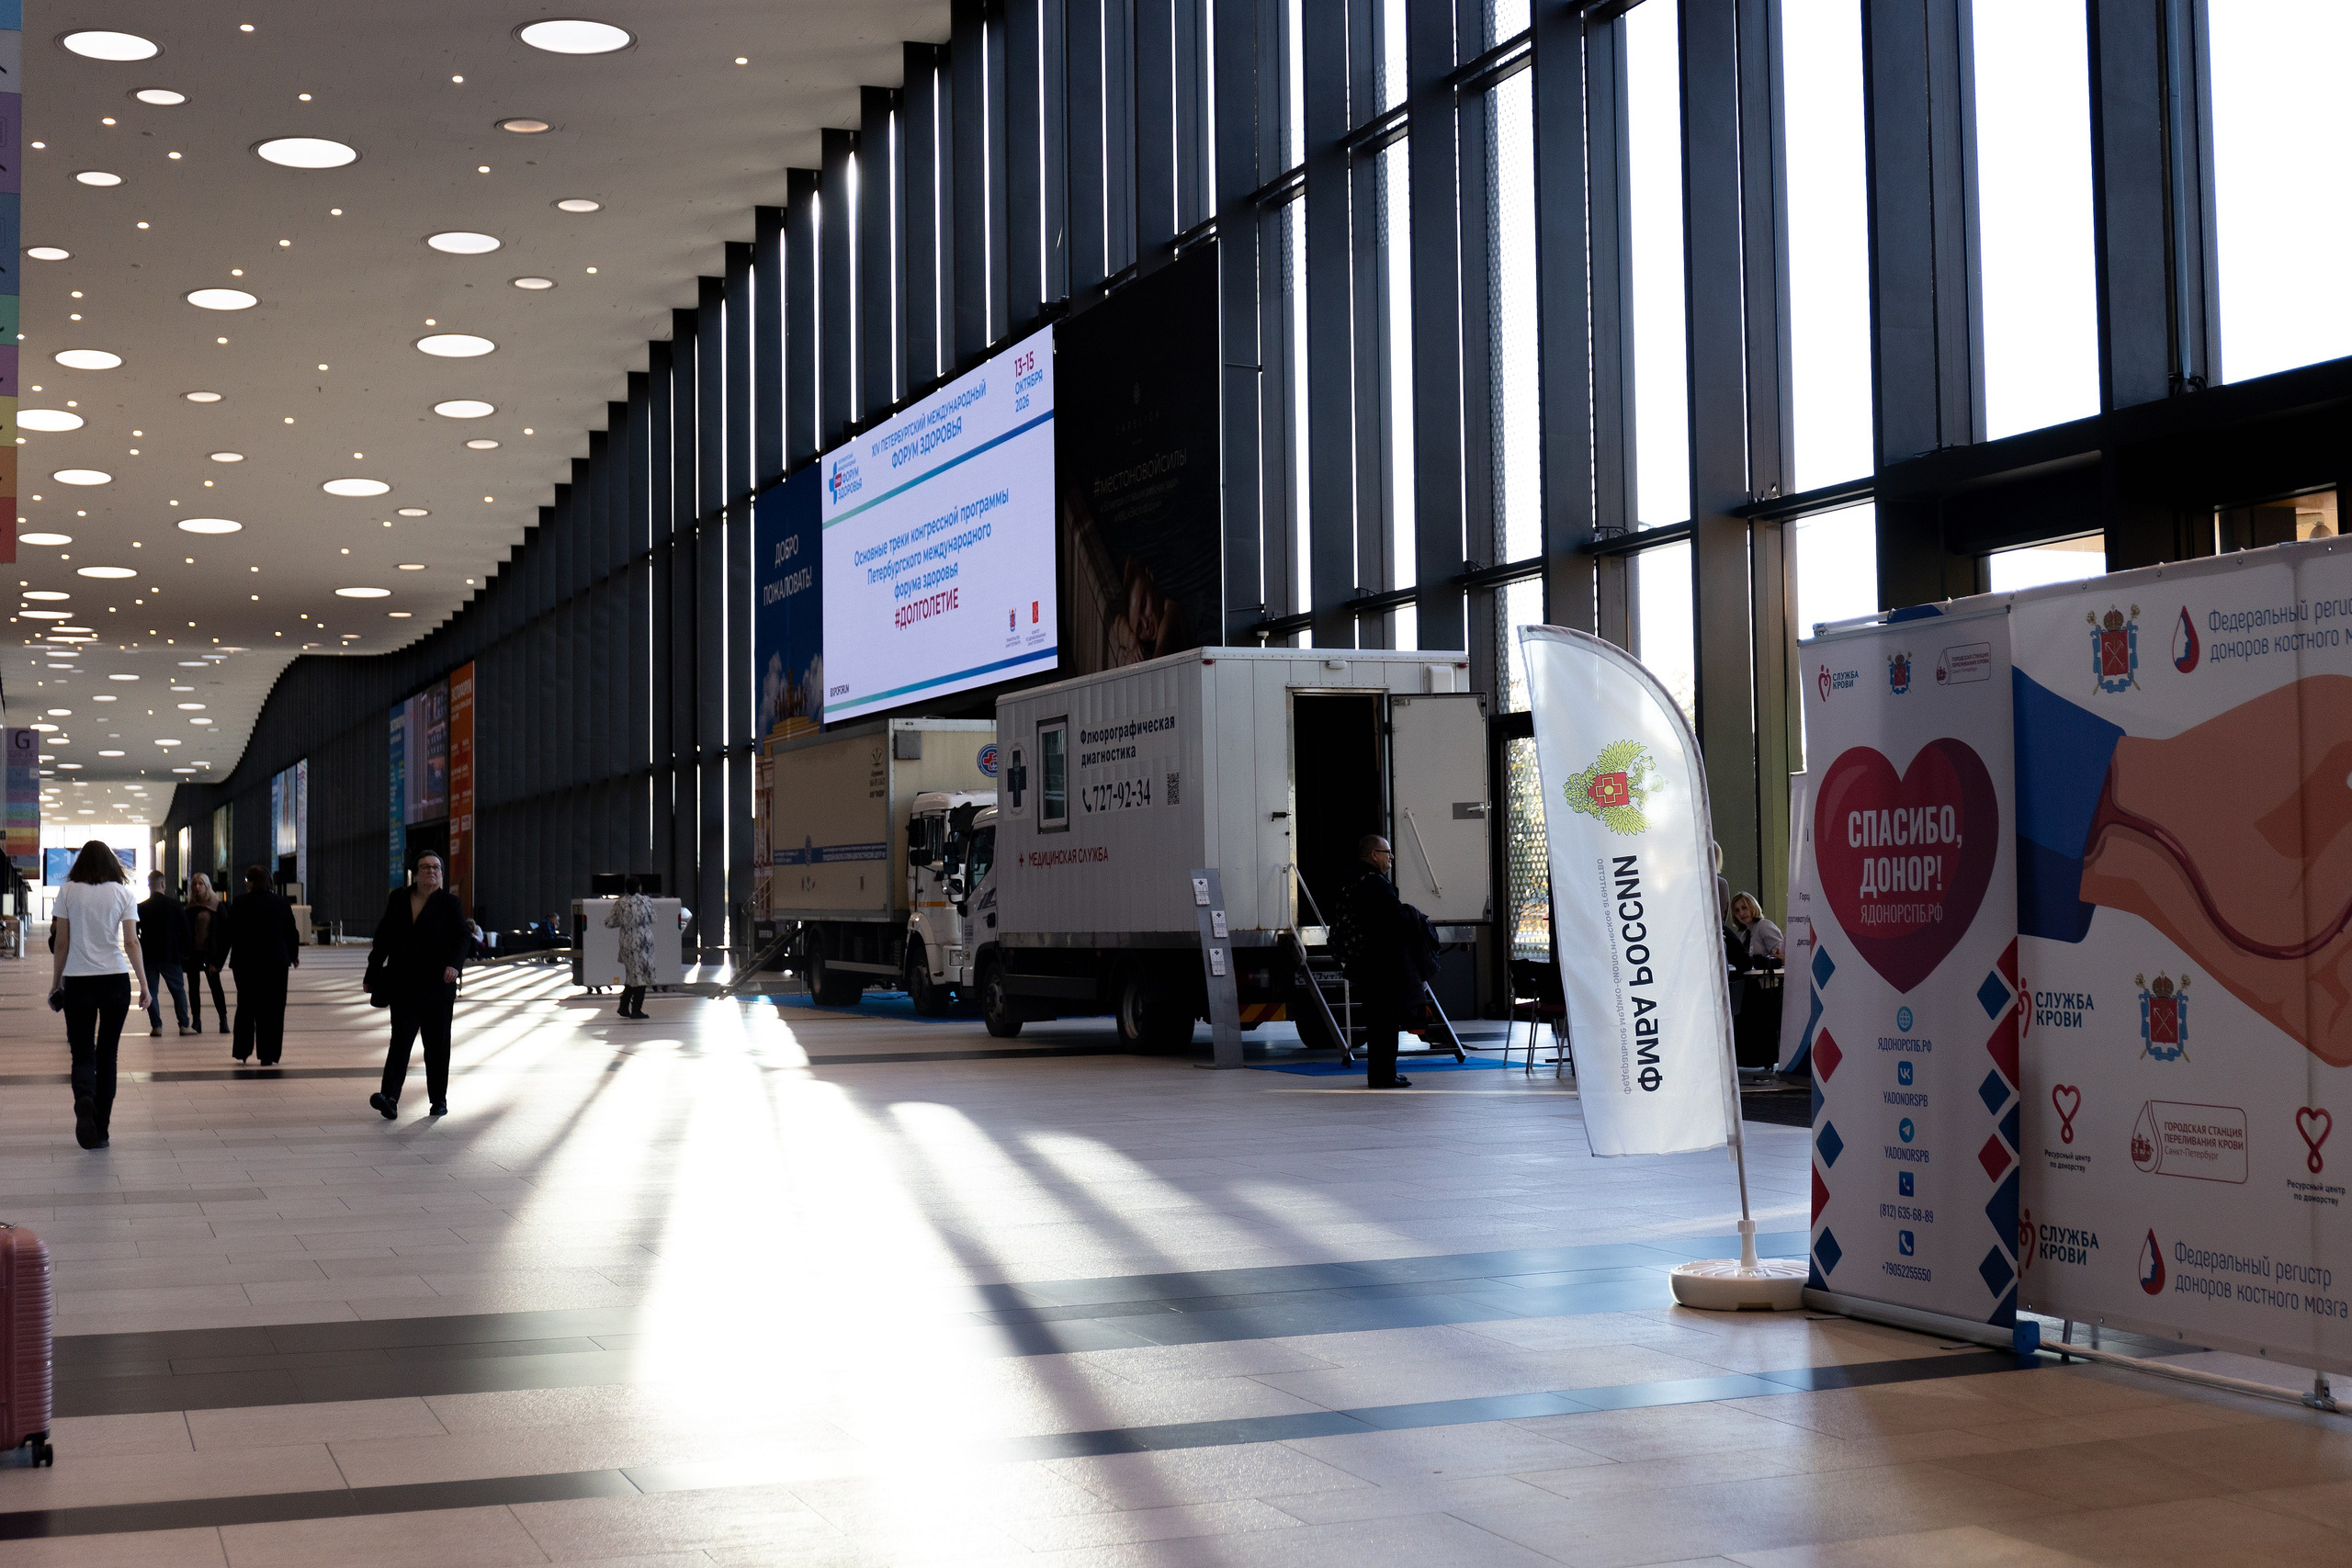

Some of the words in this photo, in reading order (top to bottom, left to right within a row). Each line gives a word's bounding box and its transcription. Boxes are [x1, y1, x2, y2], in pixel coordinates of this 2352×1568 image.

[1015, 368, 1043, 395] ОКТЯБРЯ
[1015, 393, 1030, 412] 2026
[871, 444, 880, 457] XIV
[881, 412, 926, 452] ПЕТЕРБУРГСКИЙ
[927, 378, 987, 427] МЕЖДУНАРОДНЫЙ
[891, 442, 919, 468] ФОРУМ
[920, 415, 962, 456] ЗДОРОВЬЯ
[842, 466, 859, 483] ФОРУМ
[838, 478, 863, 500] ЗДОРОВЬЯ
[854, 541, 888, 567] Основные
[889, 532, 910, 555] треки
[910, 505, 959, 544] конгрессной
[961, 488, 1009, 525] программы
[775, 534, 799, 569] ДОБРО
[867, 551, 922, 585] Петербургского
[922, 523, 991, 563] международного
[763, 565, 812, 606] ПОЖАЛОВАТЬ!
[894, 577, 922, 603] форума
[922, 562, 958, 589] здоровья
[894, 587, 959, 631] #ДОЛГОЛЕТИЕ
[2208, 599, 2308, 634] Федеральный
[2211, 637, 2269, 663] доноров
[2274, 629, 2339, 653] костного
[1832, 670, 1859, 681] СЛУЖБА
[1832, 680, 1854, 690] КРОВИ
[16, 730, 29, 750] G
[1080, 716, 1175, 745] Флюорографическая
[1081, 745, 1136, 769] диагностика
[1093, 778, 1150, 812] 727-92-34
[1848, 805, 1962, 849] СПАСИБО,
[1029, 849, 1077, 869] МЕДИЦИНСКАЯ
[1078, 846, 1108, 863] СЛУЖБА
[1860, 855, 1942, 899] ДОНОР!
[1860, 902, 1943, 926] ЯДОНОРСПБ.РФ
[2035, 991, 2094, 1010] СЛУЖБА
[2036, 1010, 2082, 1028] КРОВИ
[1877, 1037, 1932, 1054] ЯДОНОРСПБ.РФ
[1883, 1091, 1928, 1108] YADONORSPB
[2164, 1121, 2207, 1134] ГОРОДСКАЯ
[2208, 1125, 2243, 1138] СТАНЦИЯ
[1883, 1145, 1929, 1163] YADONORSPB
[2165, 1134, 2217, 1148] ПЕРЕЛИВАНИЯ
[2218, 1139, 2244, 1151] КРОВИ
[2165, 1146, 2219, 1161] Санкт-Петербург
[2044, 1149, 2074, 1162] Ресурсный
[2075, 1153, 2091, 1164] центр
[2057, 1161, 2086, 1173] донорству
[2287, 1179, 2324, 1193] Ресурсный
[2324, 1184, 2346, 1195] центр
[2302, 1193, 2339, 1207] донорству
[1880, 1203, 1896, 1220] (812)
[1897, 1206, 1934, 1224] 635-68-89
[2040, 1224, 2099, 1249] СЛУЖБА
[2040, 1242, 2086, 1266] КРОВИ
[1882, 1262, 1932, 1282] +79052255550
[2175, 1240, 2270, 1277] Федеральный
[2276, 1262, 2332, 1292] регистр
[2175, 1274, 2233, 1301] доноров
[2237, 1284, 2299, 1310] костного
[2304, 1295, 2348, 1319] мозга
